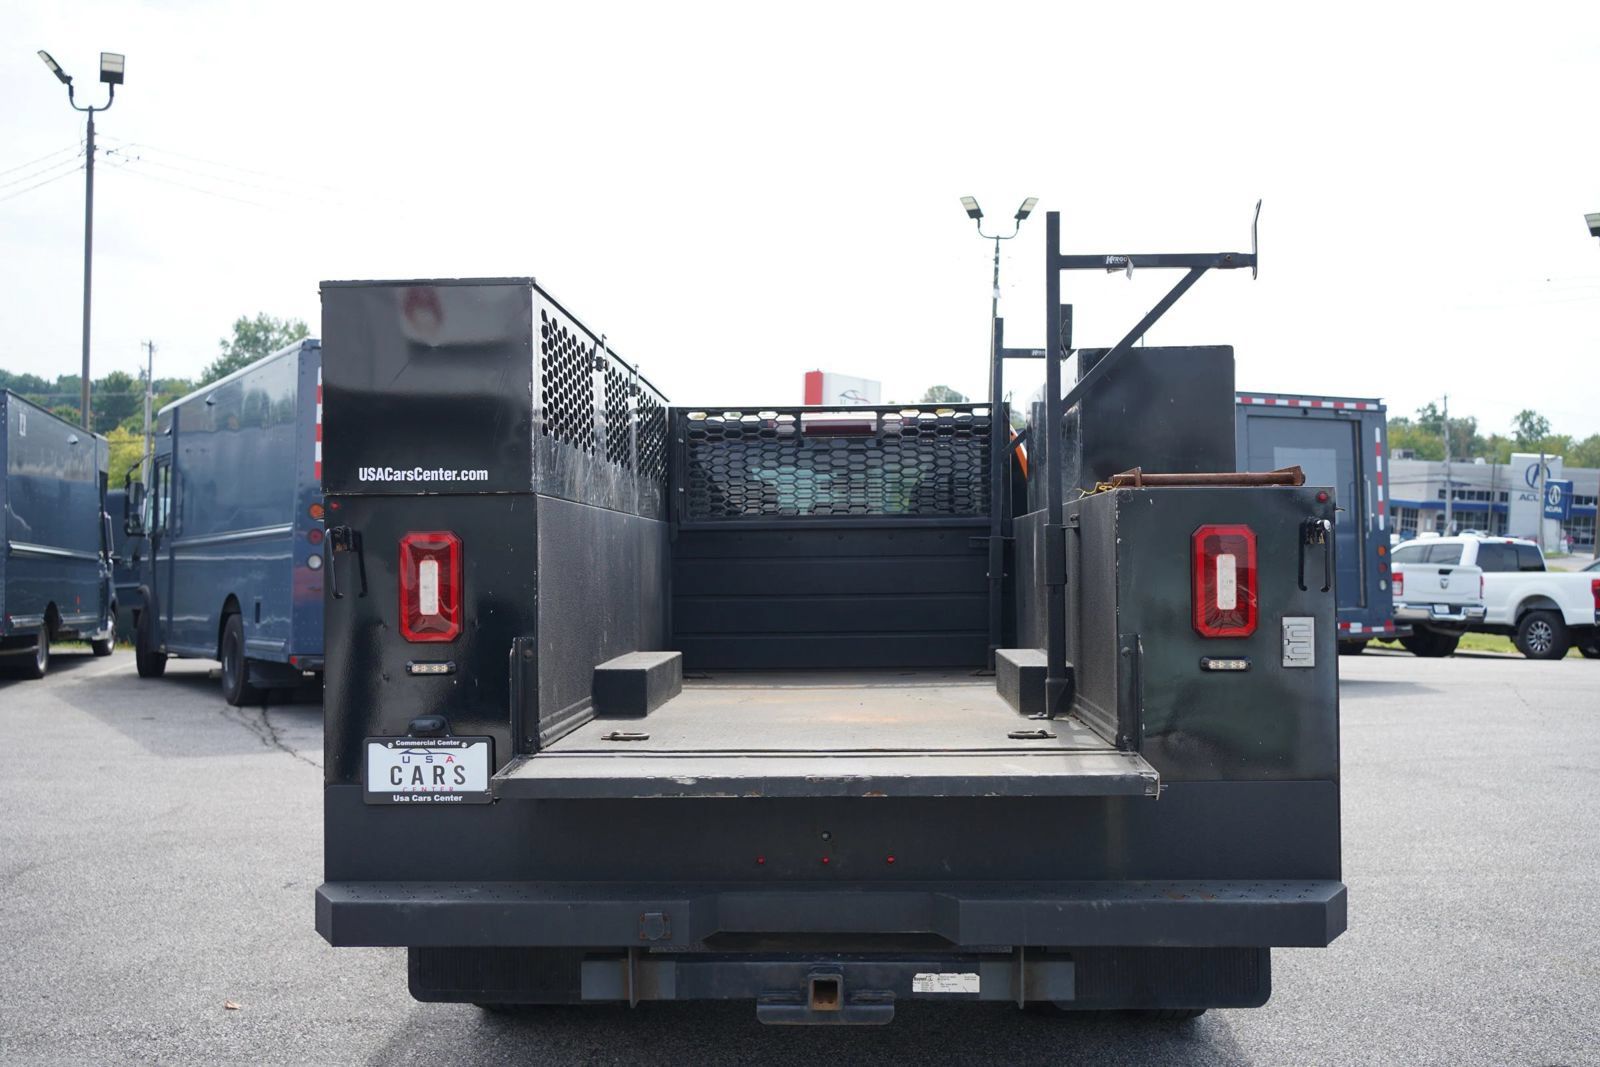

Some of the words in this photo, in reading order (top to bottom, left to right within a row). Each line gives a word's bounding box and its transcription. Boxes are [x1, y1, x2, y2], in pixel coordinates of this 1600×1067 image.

[358, 466, 489, 481] USACarsCenter.com
[395, 739, 436, 747] Commercial
[437, 739, 460, 747] Center
[390, 765, 466, 786] CARS
[392, 794, 410, 802] Usa
[411, 794, 432, 802] Cars
[433, 794, 463, 802] Center
